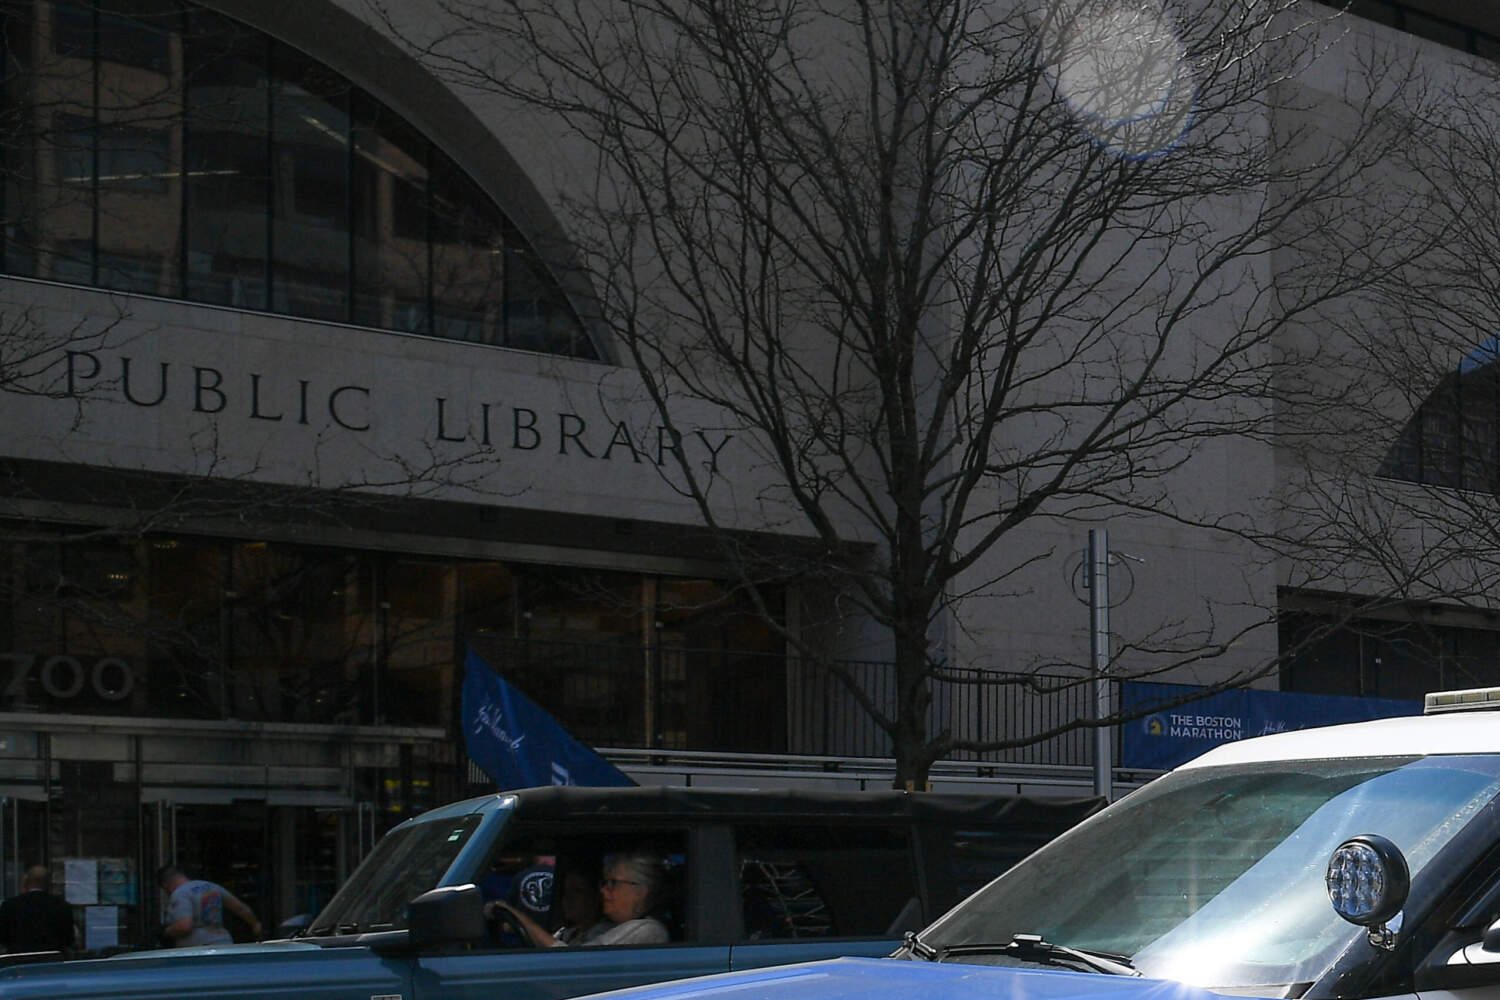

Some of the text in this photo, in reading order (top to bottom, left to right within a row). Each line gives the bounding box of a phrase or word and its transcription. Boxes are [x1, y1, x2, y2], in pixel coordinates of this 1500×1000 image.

[65, 350, 735, 473] PUBLIC LIBRARY
[0, 653, 134, 700] 700
[1170, 714, 1241, 728] THE BOSTON
[1170, 727, 1242, 740] MARATHON
